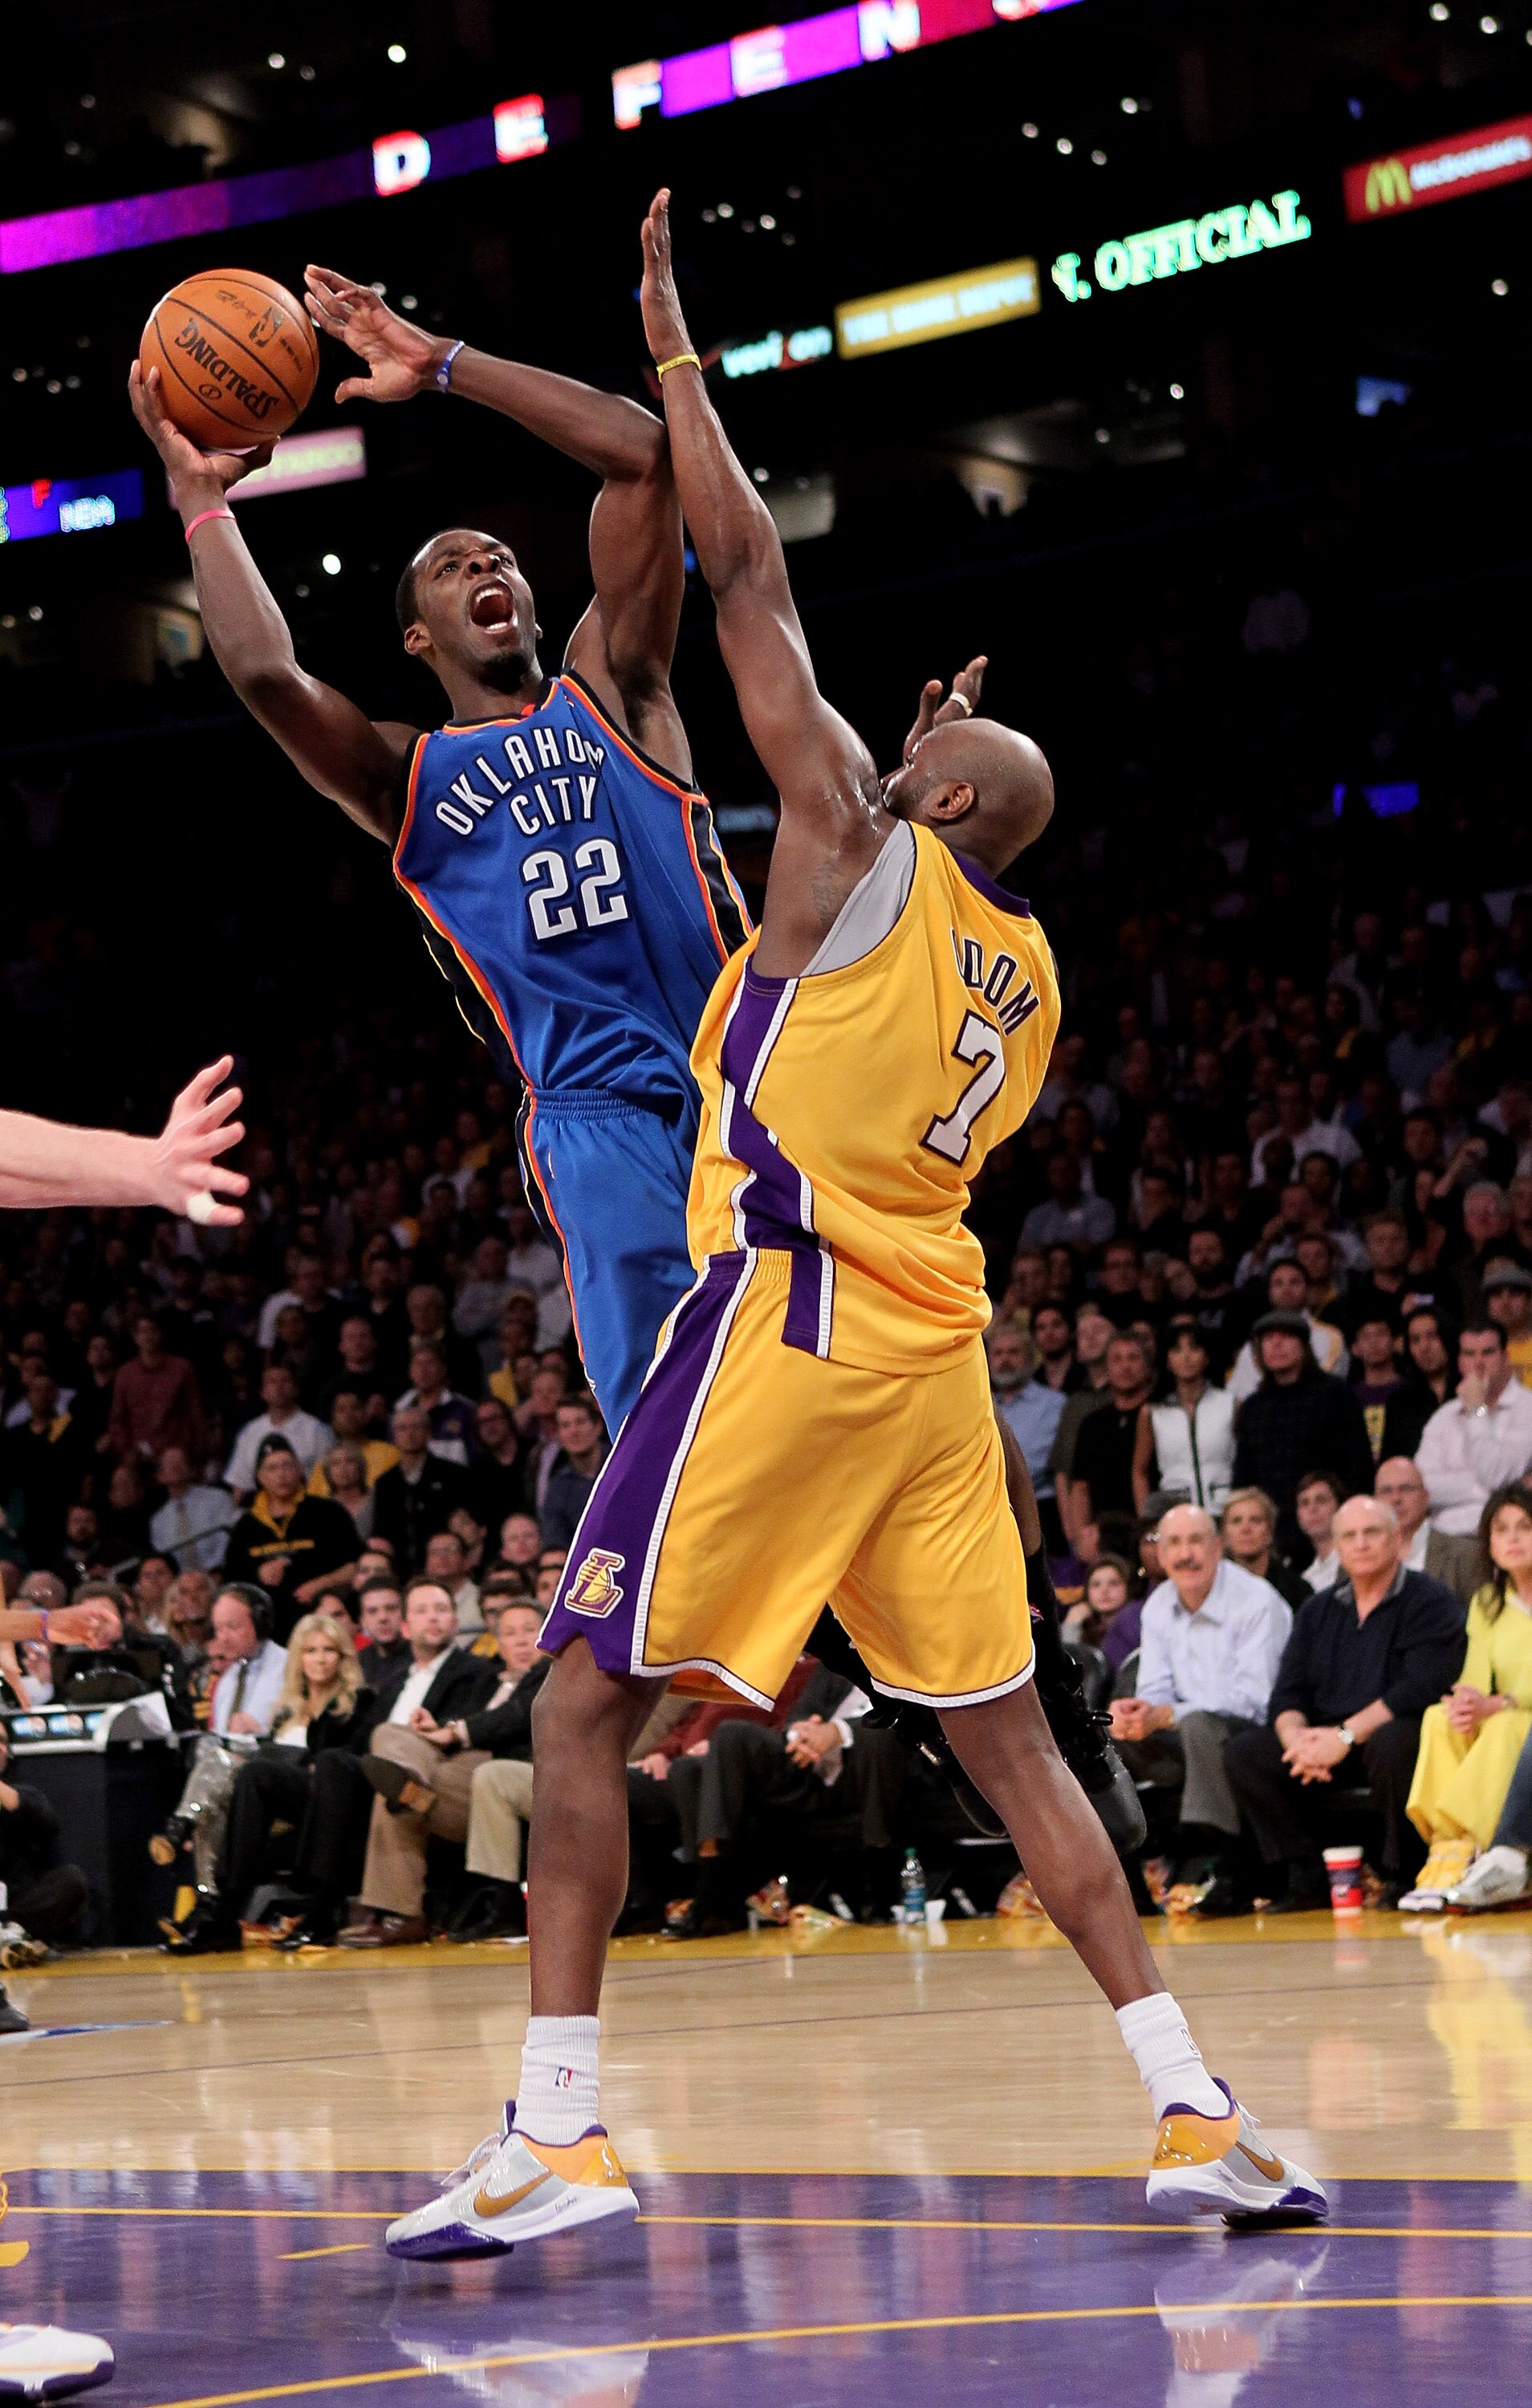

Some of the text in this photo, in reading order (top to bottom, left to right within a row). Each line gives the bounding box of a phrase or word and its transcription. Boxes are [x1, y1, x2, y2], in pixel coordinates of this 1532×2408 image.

[1095, 189, 1311, 291] OFFICIAL
[174, 317, 280, 420] SPALDING
[510, 775, 597, 836] CITY
[522, 838, 629, 940] 22
[950, 925, 1041, 1038] DOM
[920, 1008, 1007, 1167] 7
